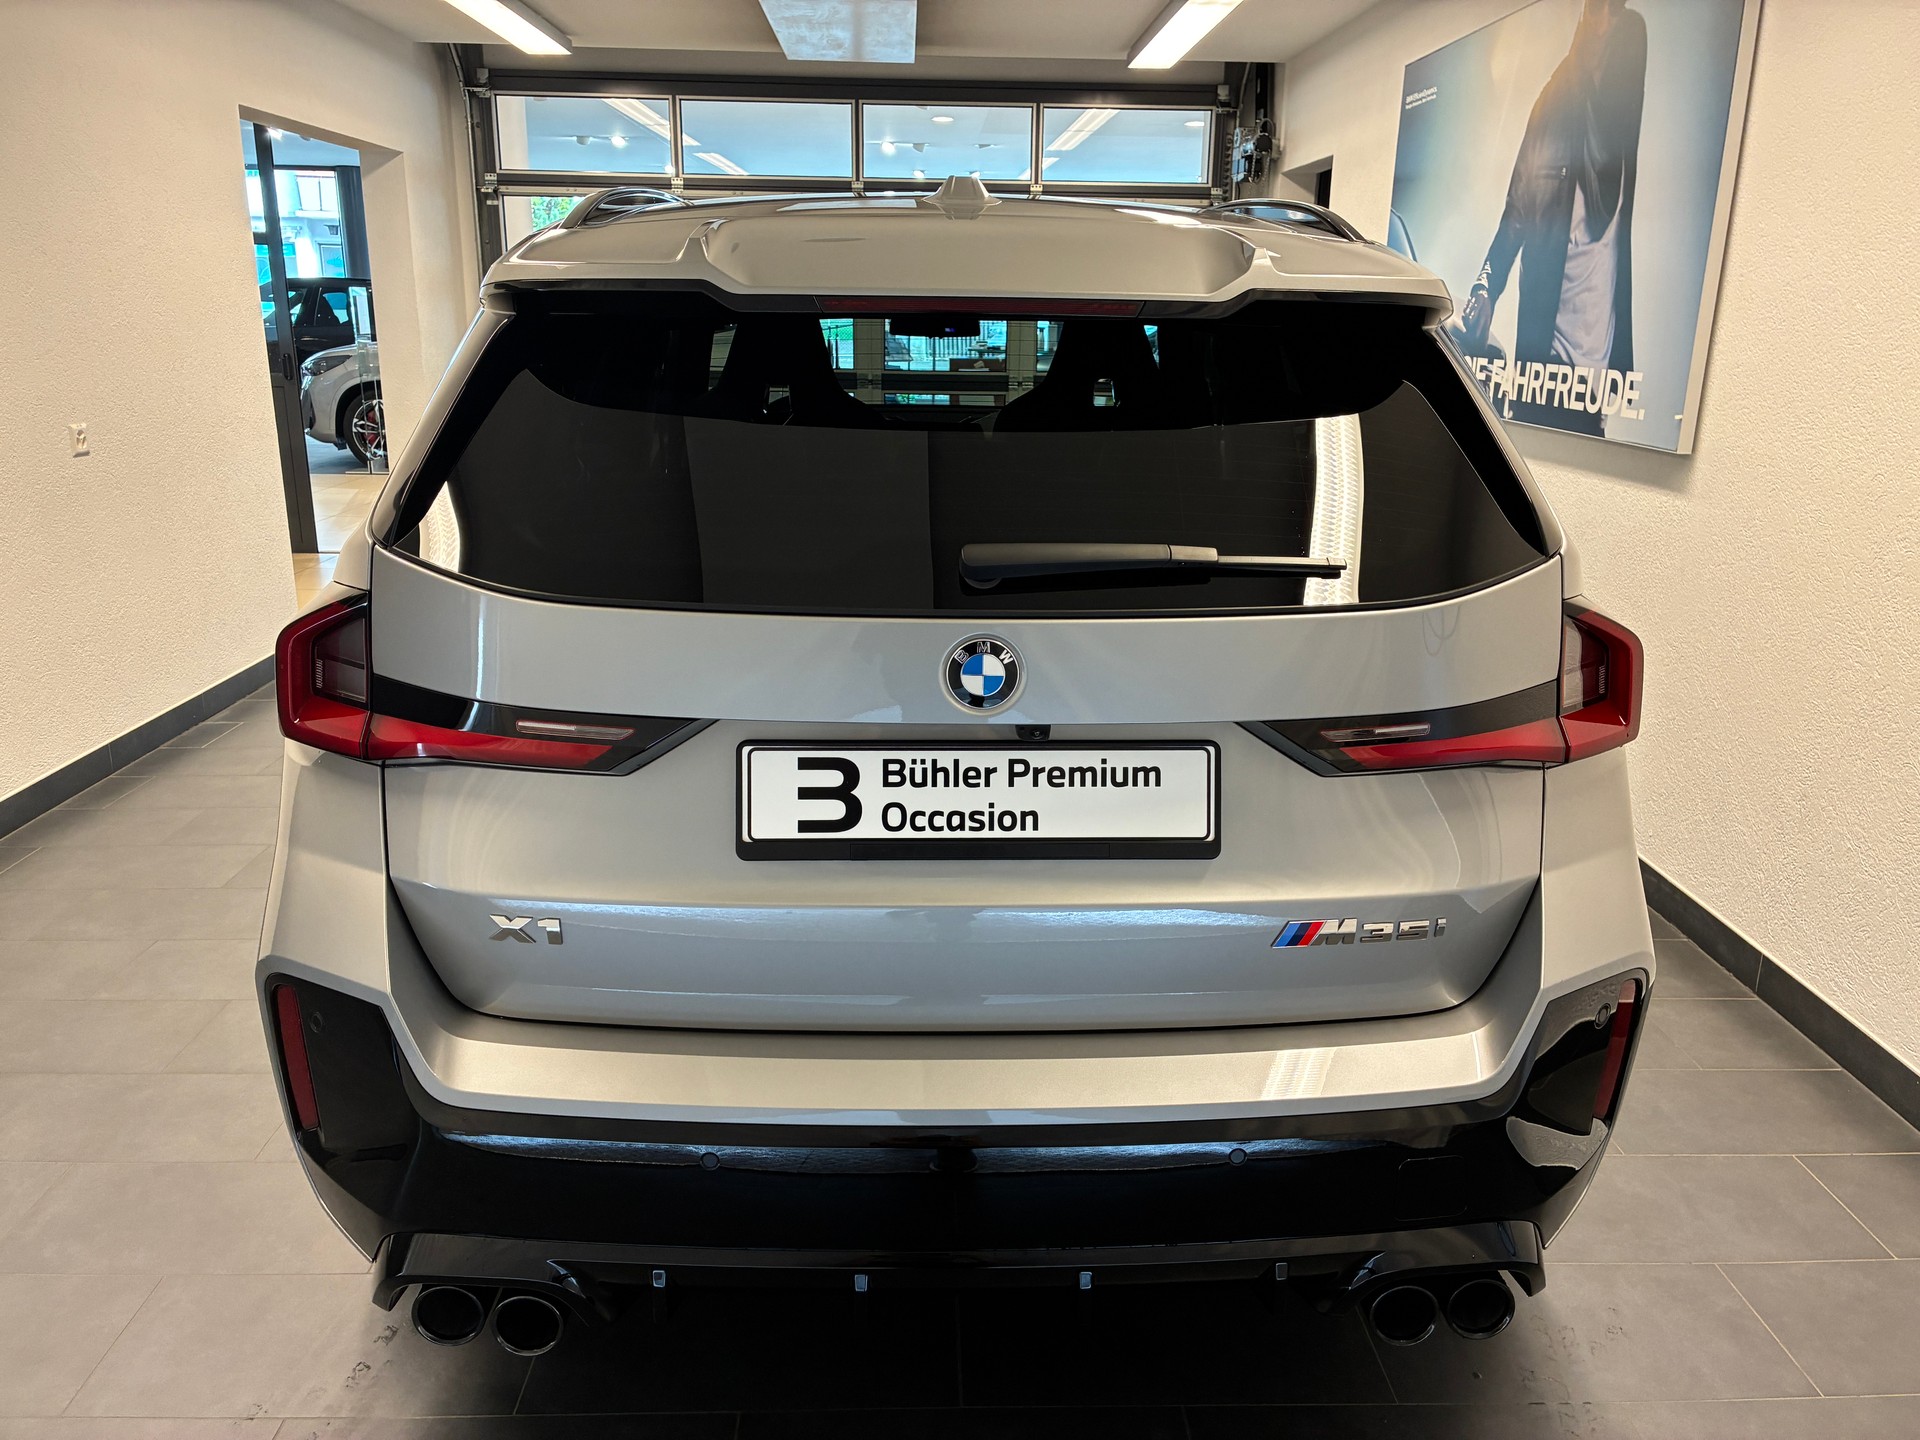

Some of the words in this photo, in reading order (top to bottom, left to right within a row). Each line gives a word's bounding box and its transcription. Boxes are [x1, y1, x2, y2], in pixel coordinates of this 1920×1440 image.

[954, 641, 1014, 665] BMW
[882, 758, 998, 788] Bühler
[1008, 758, 1162, 788] Premium
[881, 802, 1039, 833] Occasion
[488, 913, 564, 945] X1
[1309, 917, 1448, 947] M35i
